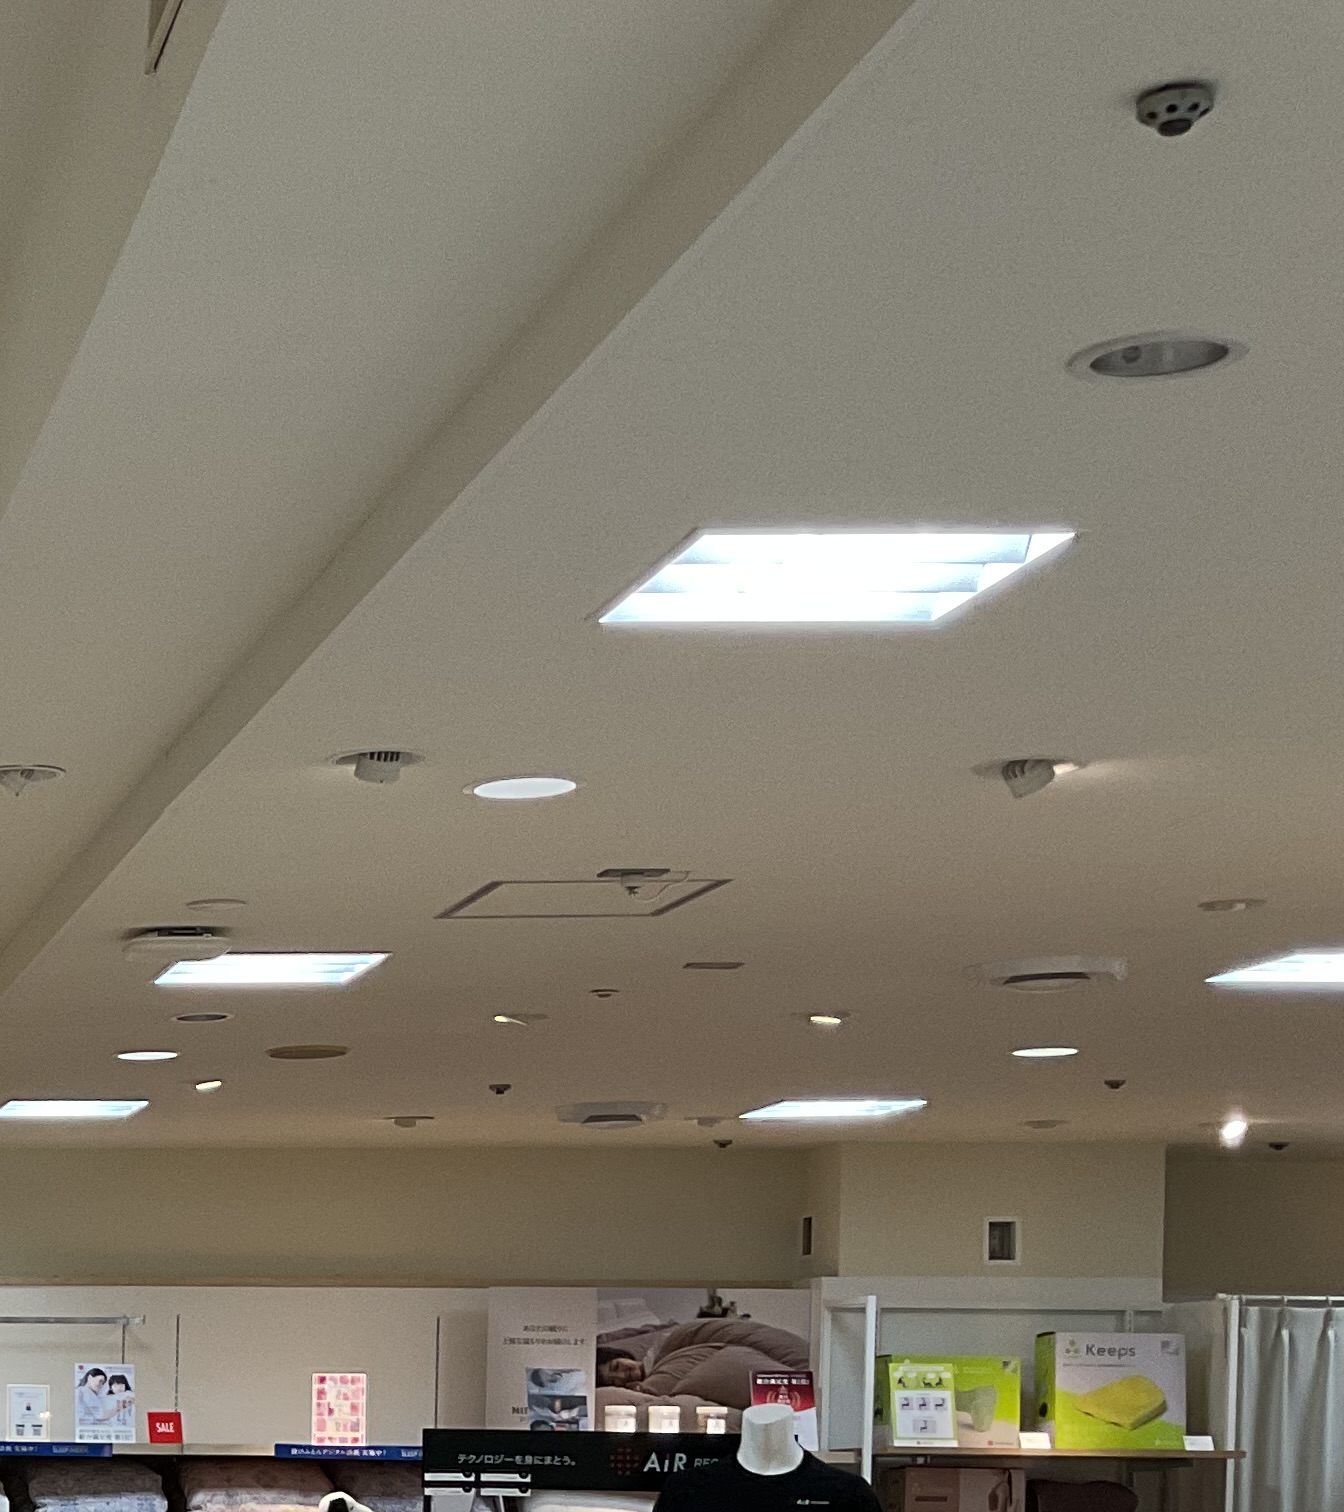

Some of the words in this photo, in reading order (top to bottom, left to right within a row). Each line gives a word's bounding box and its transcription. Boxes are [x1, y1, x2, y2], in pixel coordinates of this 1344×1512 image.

[1084, 1343, 1137, 1360] Keeps
[155, 1422, 175, 1433] SALE
[457, 1453, 576, 1466] テクノロジーを身にまとう。
[643, 1452, 687, 1472] AiR
